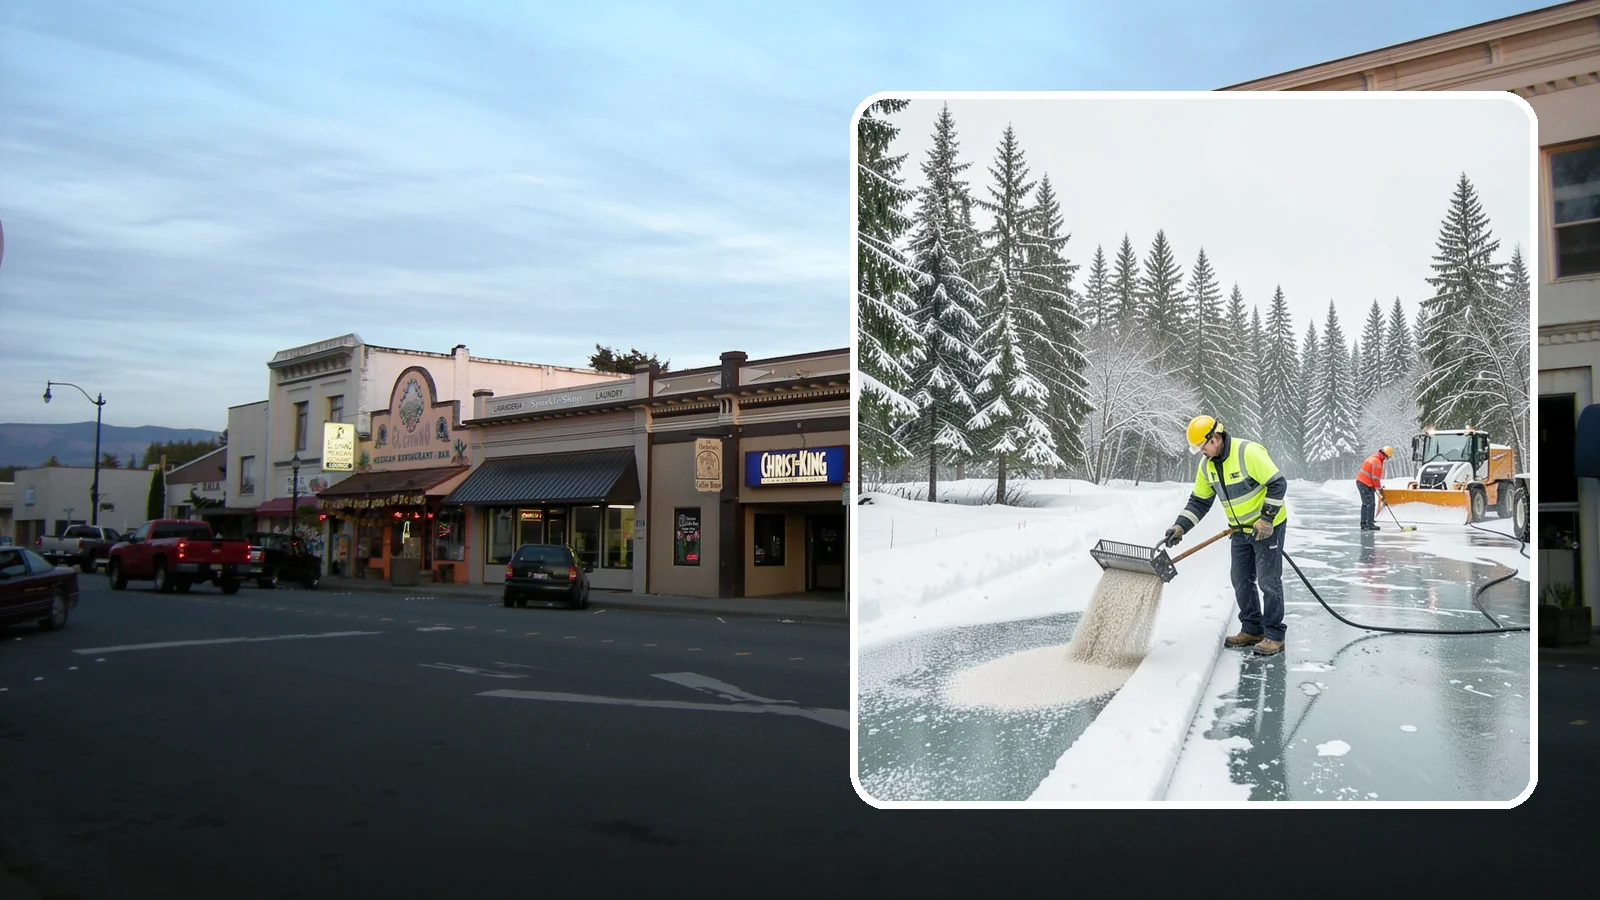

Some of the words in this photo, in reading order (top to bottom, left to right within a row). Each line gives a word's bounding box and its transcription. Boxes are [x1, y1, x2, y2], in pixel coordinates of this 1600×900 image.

[595, 389, 623, 399] LAUNDRY
[493, 402, 522, 412] LAVANDERIA
[531, 397, 560, 408] Sparkle
[562, 395, 582, 405] Shop
[373, 455, 396, 464] MEXICAN
[397, 451, 433, 462] RESTAURANT
[437, 450, 450, 459] BAR
[760, 452, 797, 478] CHRIST
[799, 450, 827, 476] KING
